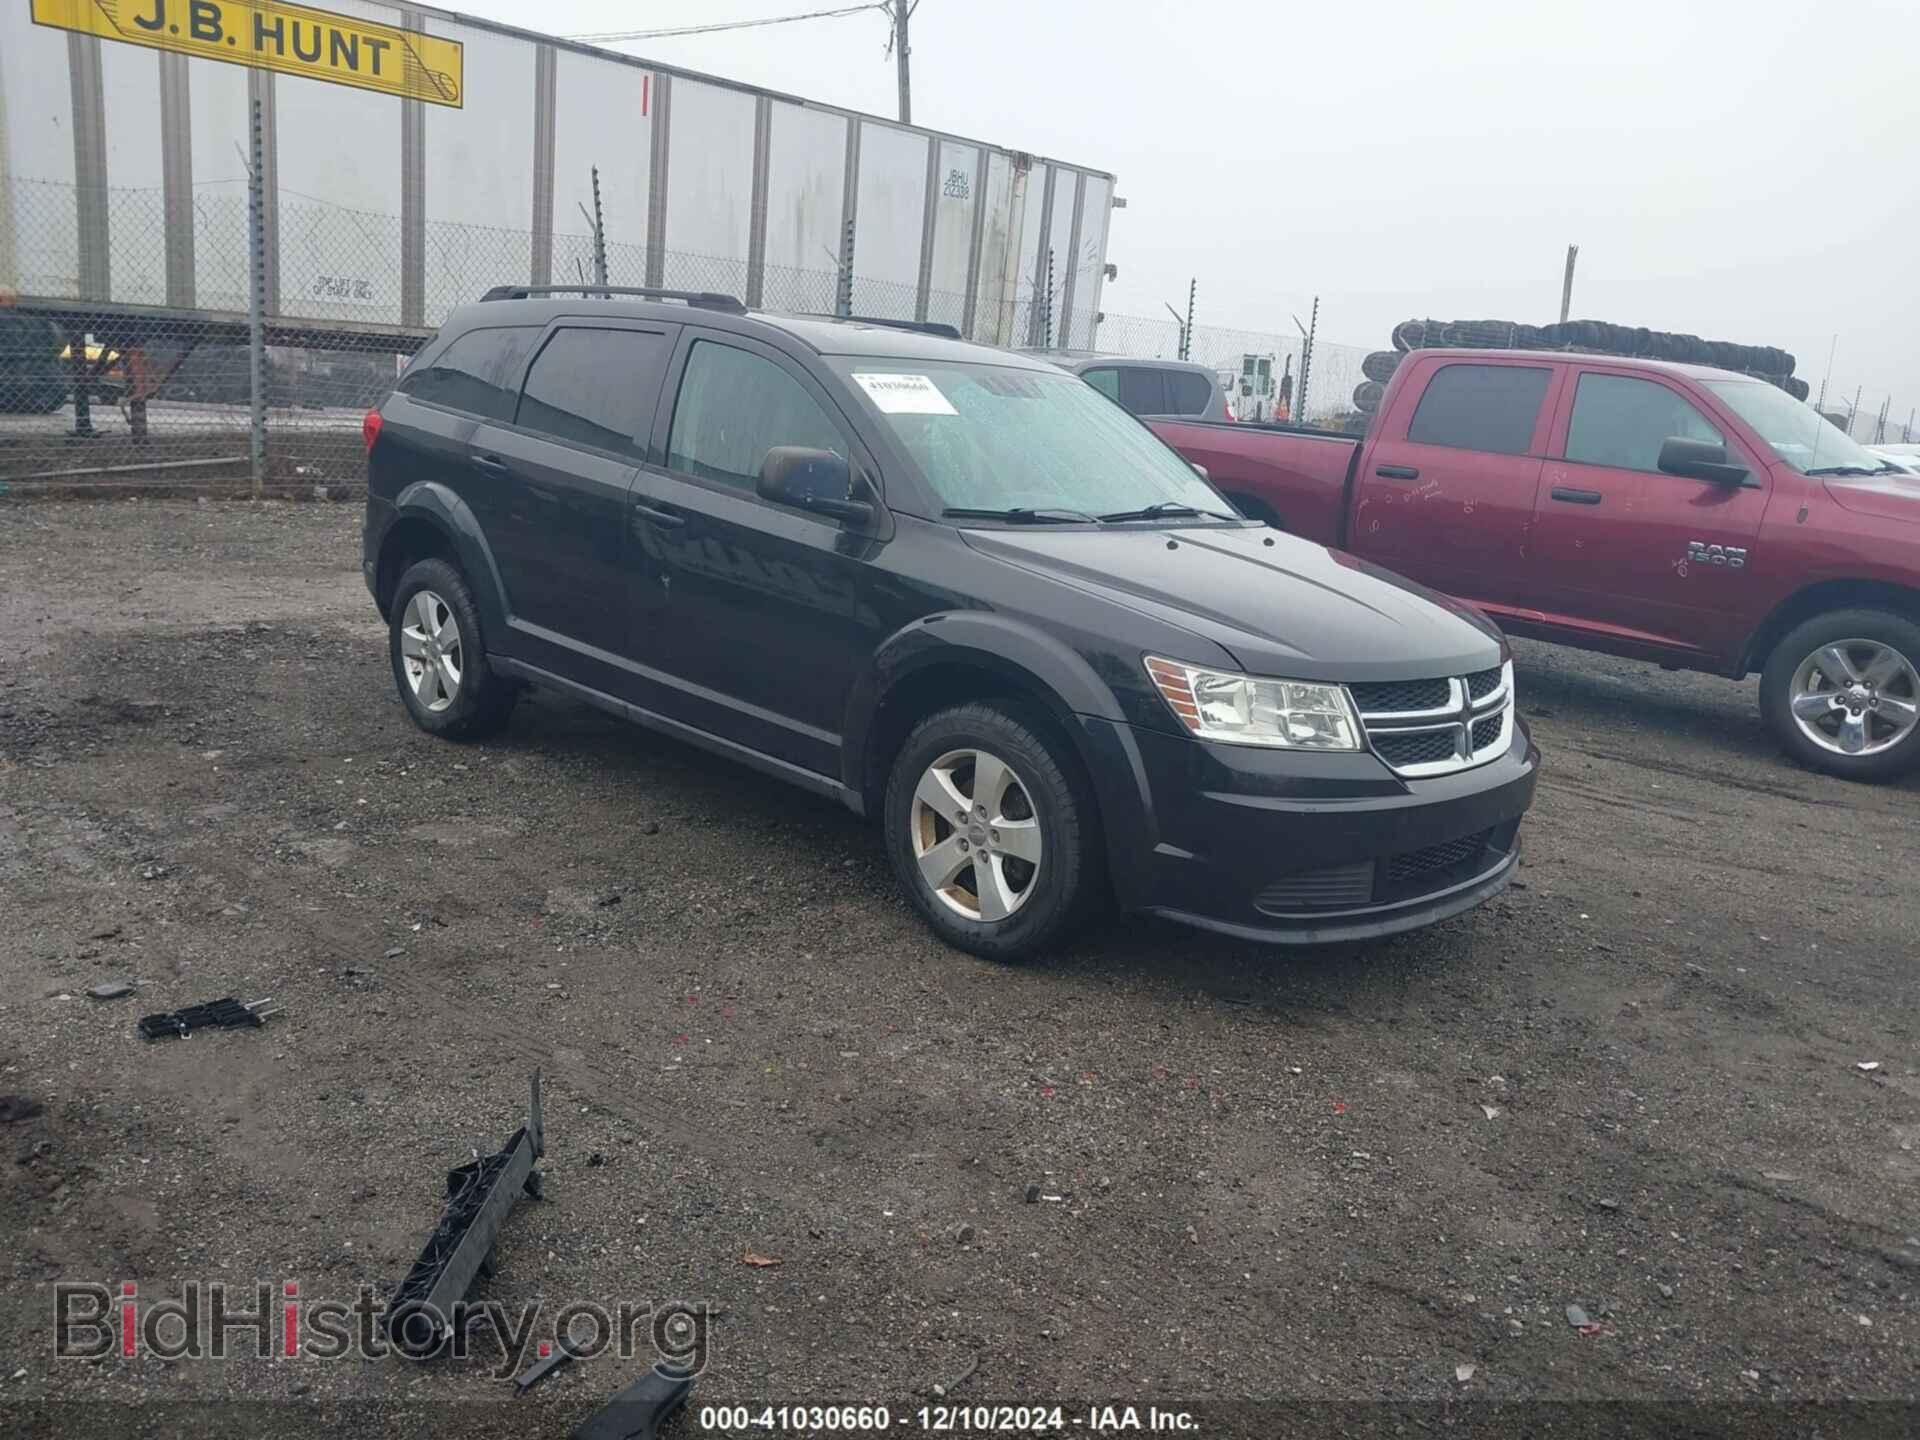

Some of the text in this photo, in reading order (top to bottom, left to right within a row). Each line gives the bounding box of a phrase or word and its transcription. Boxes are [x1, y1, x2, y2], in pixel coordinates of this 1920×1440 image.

[134, 0, 391, 76] J.B. HUNT
[947, 168, 969, 186] JBHU
[1688, 541, 1747, 558] RAM
[1687, 550, 1745, 569] 1500
